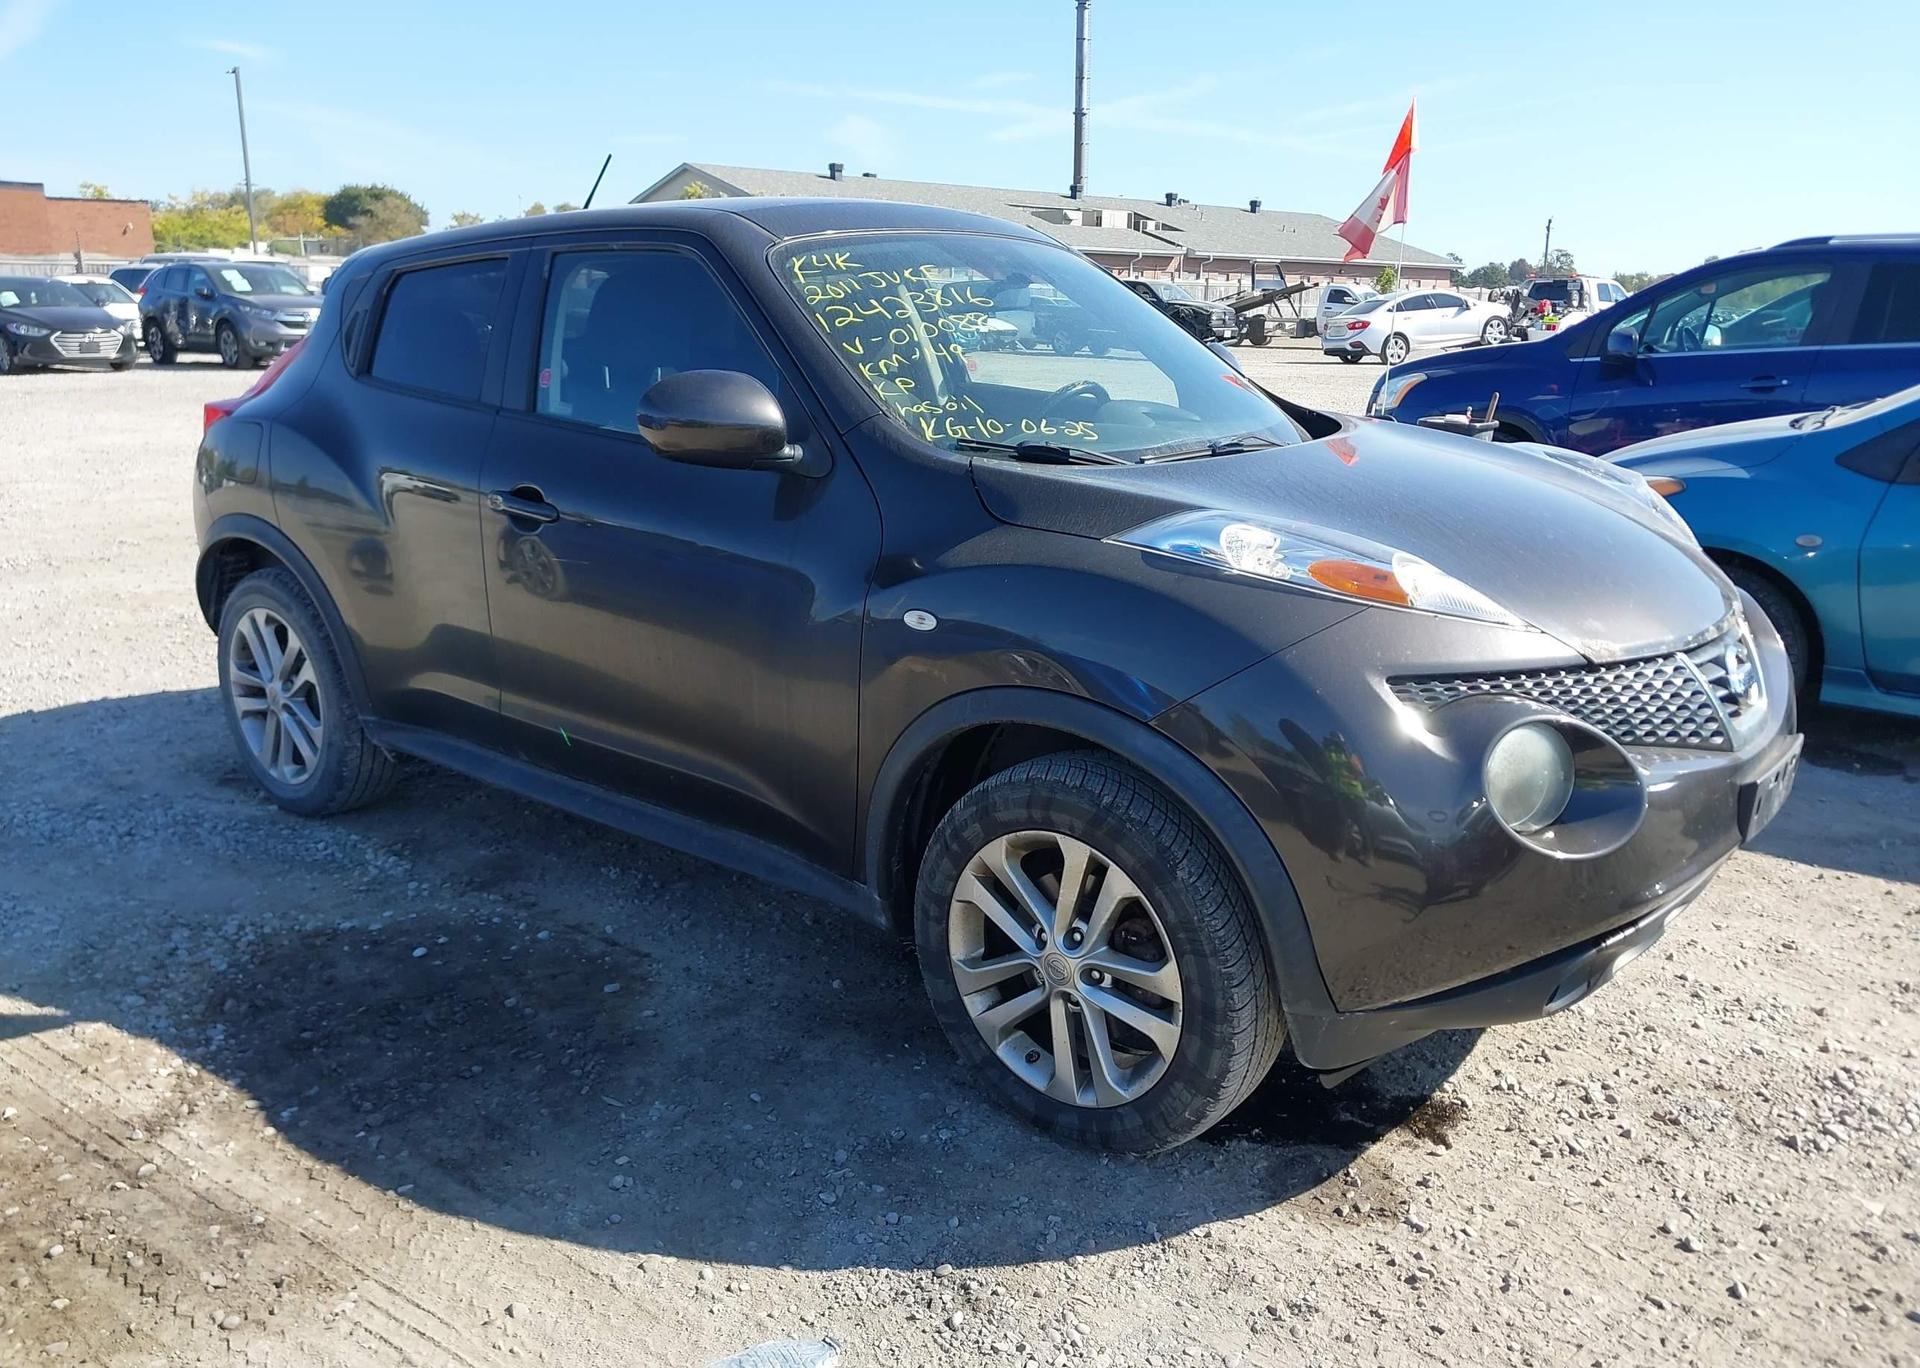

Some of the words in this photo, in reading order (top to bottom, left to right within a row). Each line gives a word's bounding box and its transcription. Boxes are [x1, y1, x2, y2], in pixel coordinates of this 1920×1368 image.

[804, 277, 863, 305] 2011
[858, 264, 943, 288] JUKE
[816, 286, 995, 334] 12423816
